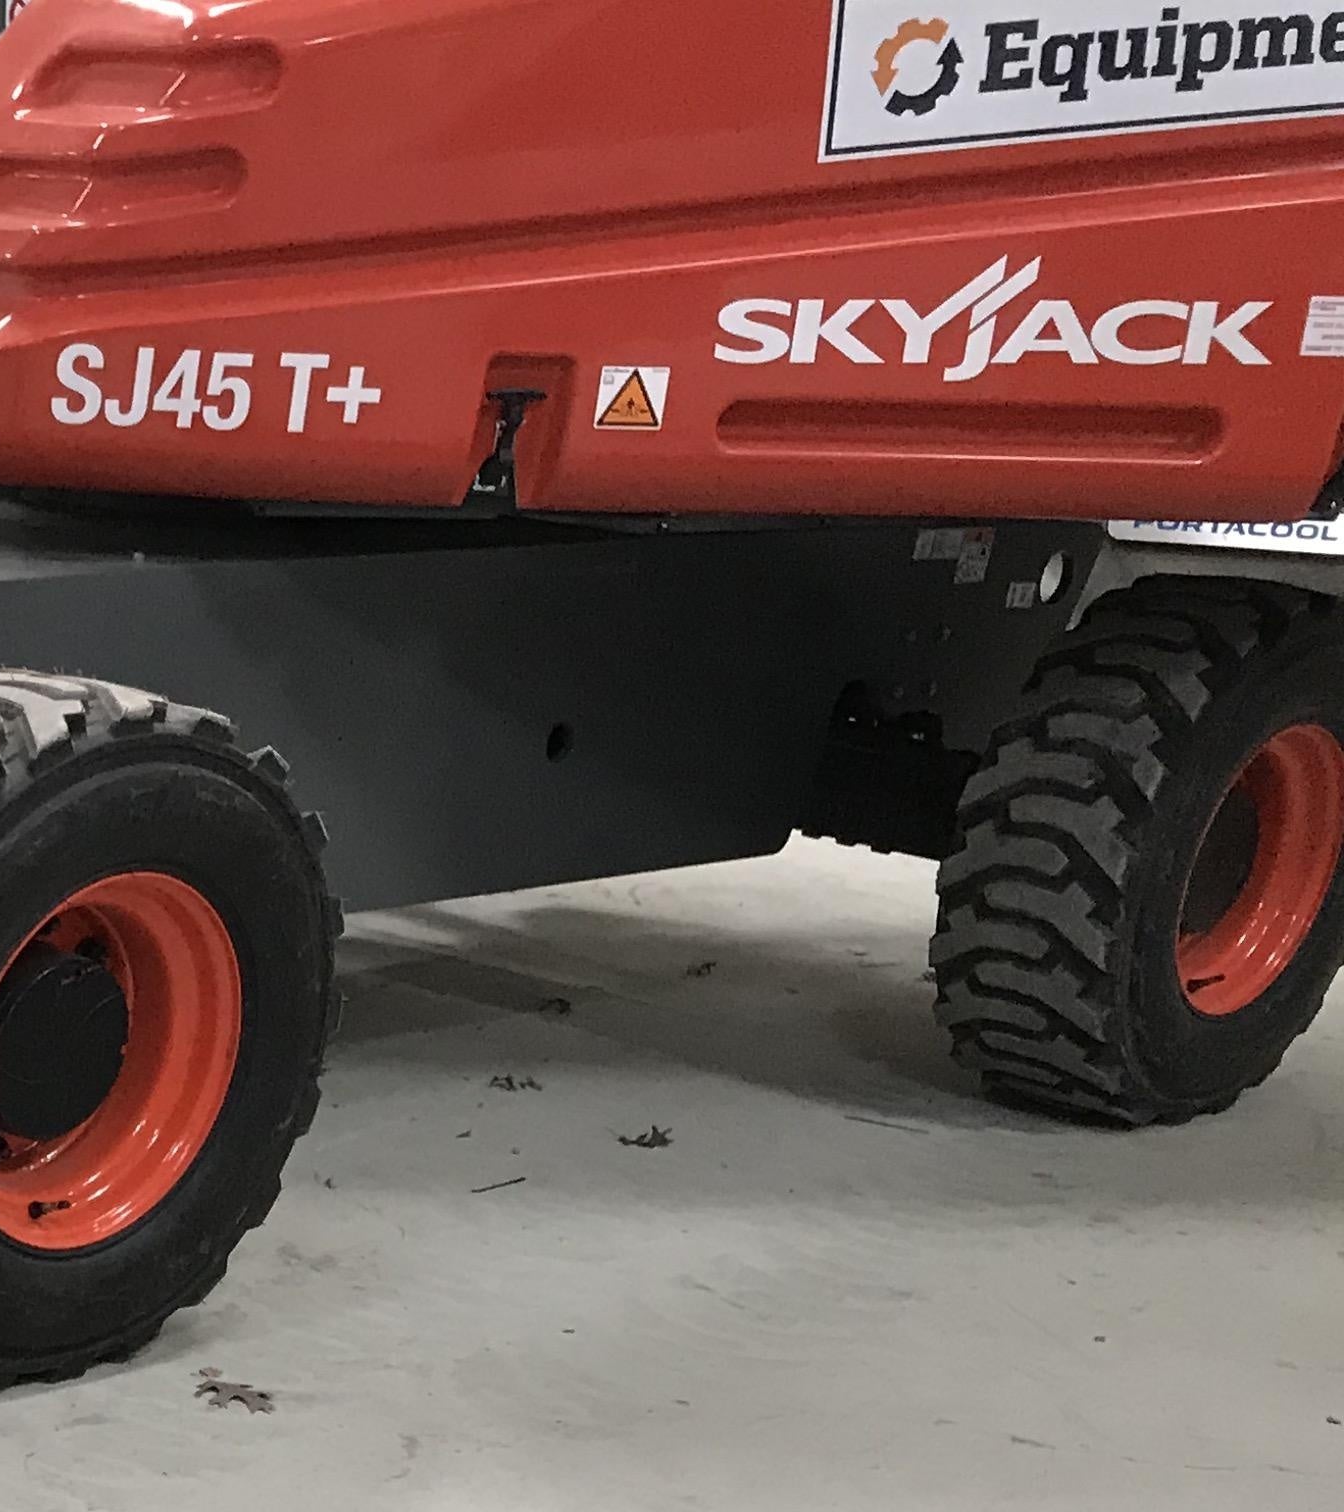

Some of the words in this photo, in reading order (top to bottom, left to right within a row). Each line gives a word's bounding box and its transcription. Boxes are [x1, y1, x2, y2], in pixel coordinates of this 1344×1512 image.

[714, 254, 1274, 382] SKYJACK
[51, 343, 254, 432] SJ45
[280, 352, 381, 433] T+
